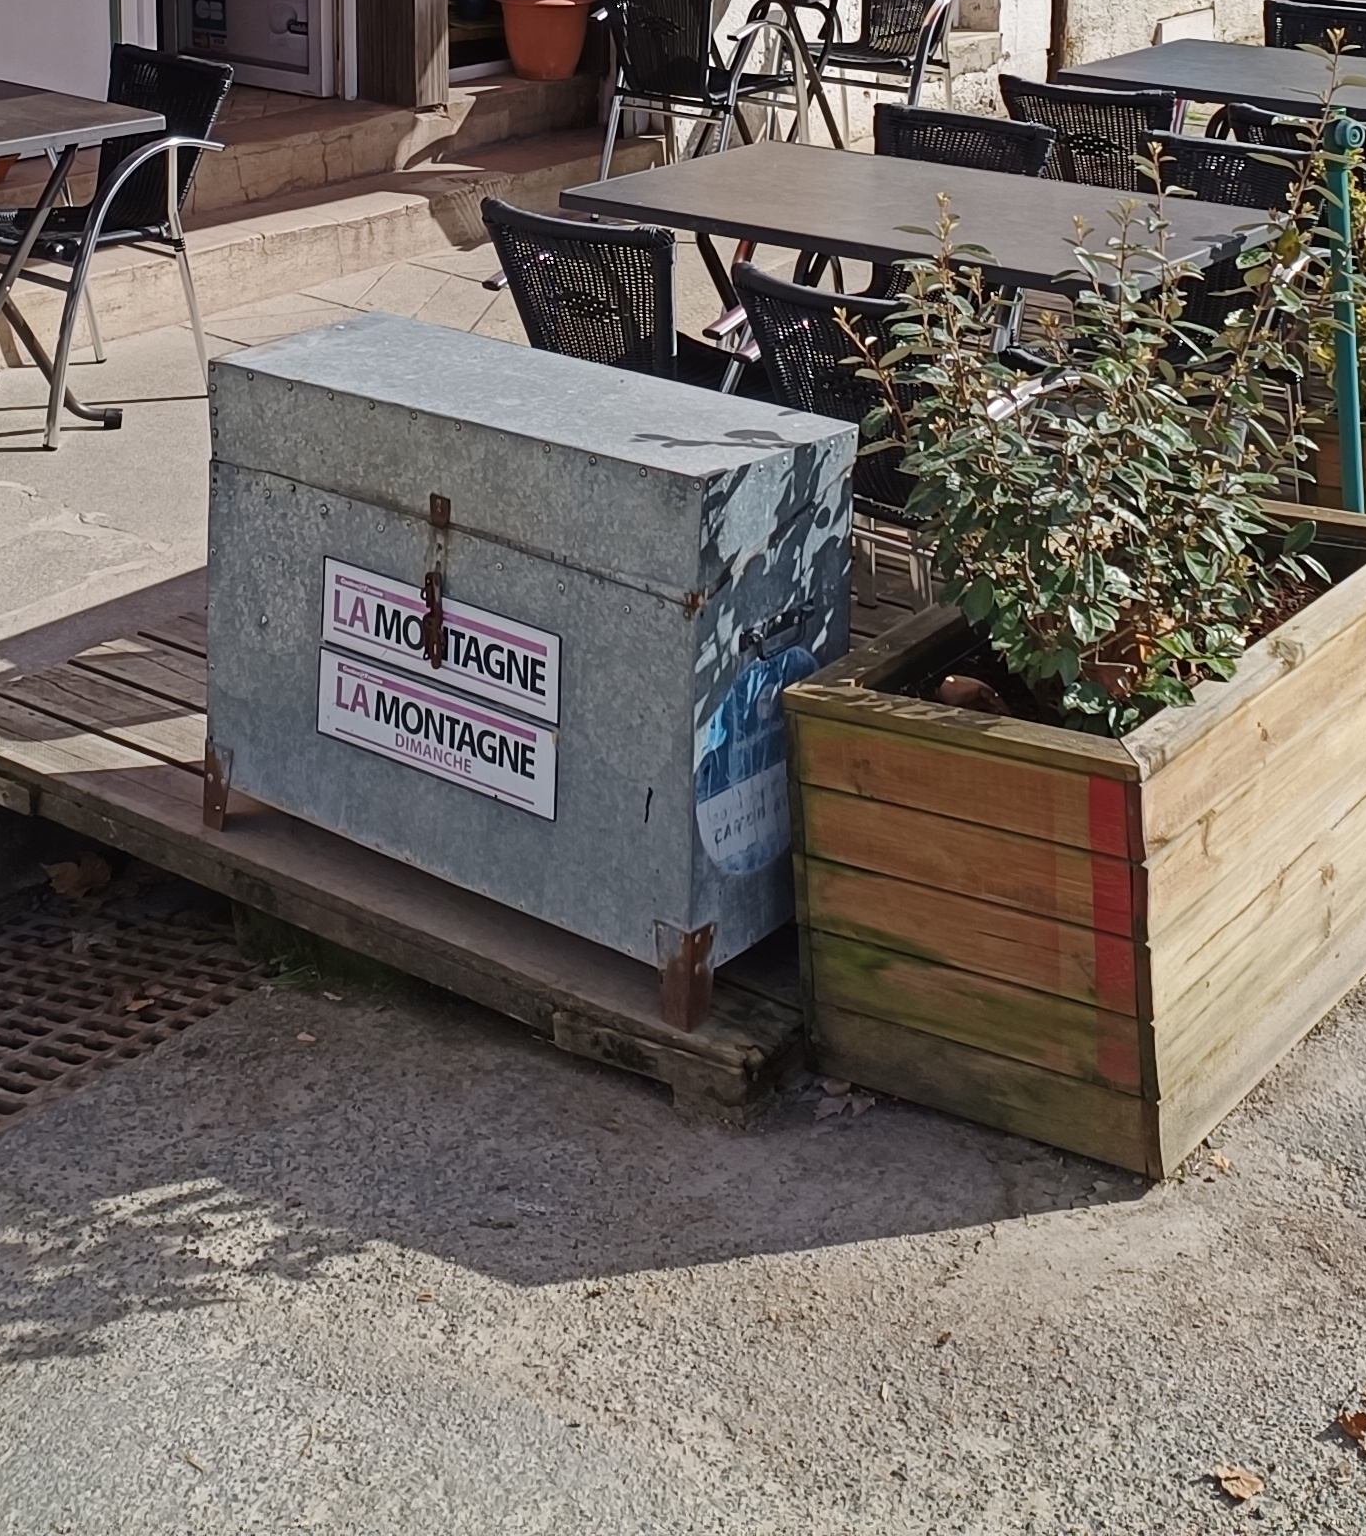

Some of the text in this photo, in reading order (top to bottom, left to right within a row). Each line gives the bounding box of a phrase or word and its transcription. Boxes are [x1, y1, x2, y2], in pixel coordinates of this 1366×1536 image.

[333, 589, 370, 634] LA
[335, 676, 535, 780] LA MONTAGNE
[395, 733, 472, 774] DIMANCHE
